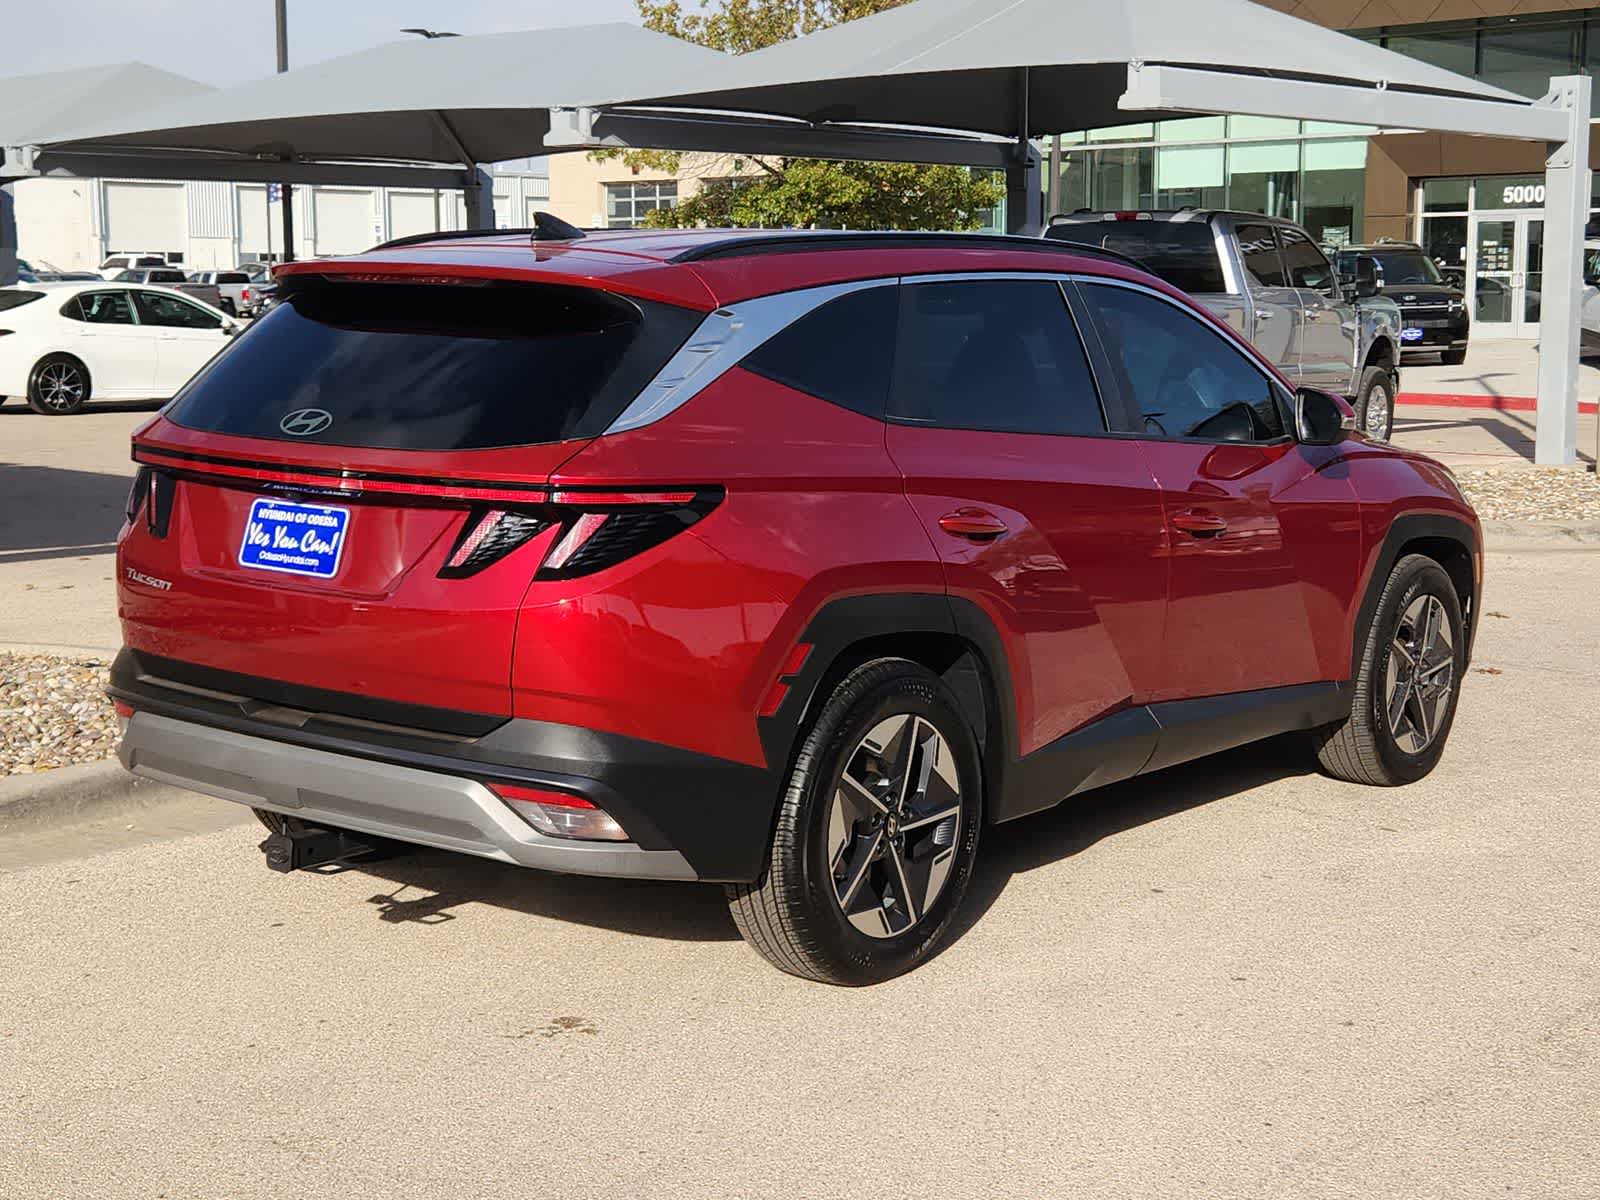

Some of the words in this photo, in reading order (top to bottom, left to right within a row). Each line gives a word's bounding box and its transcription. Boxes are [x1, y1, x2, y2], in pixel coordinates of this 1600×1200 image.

[1503, 185, 1545, 203] 5000
[258, 508, 294, 522] HYUNDAI
[295, 512, 307, 523] OF
[308, 514, 338, 527] ODESSA
[248, 522, 270, 547] Yes
[272, 525, 299, 549] You
[300, 529, 340, 555] Can!
